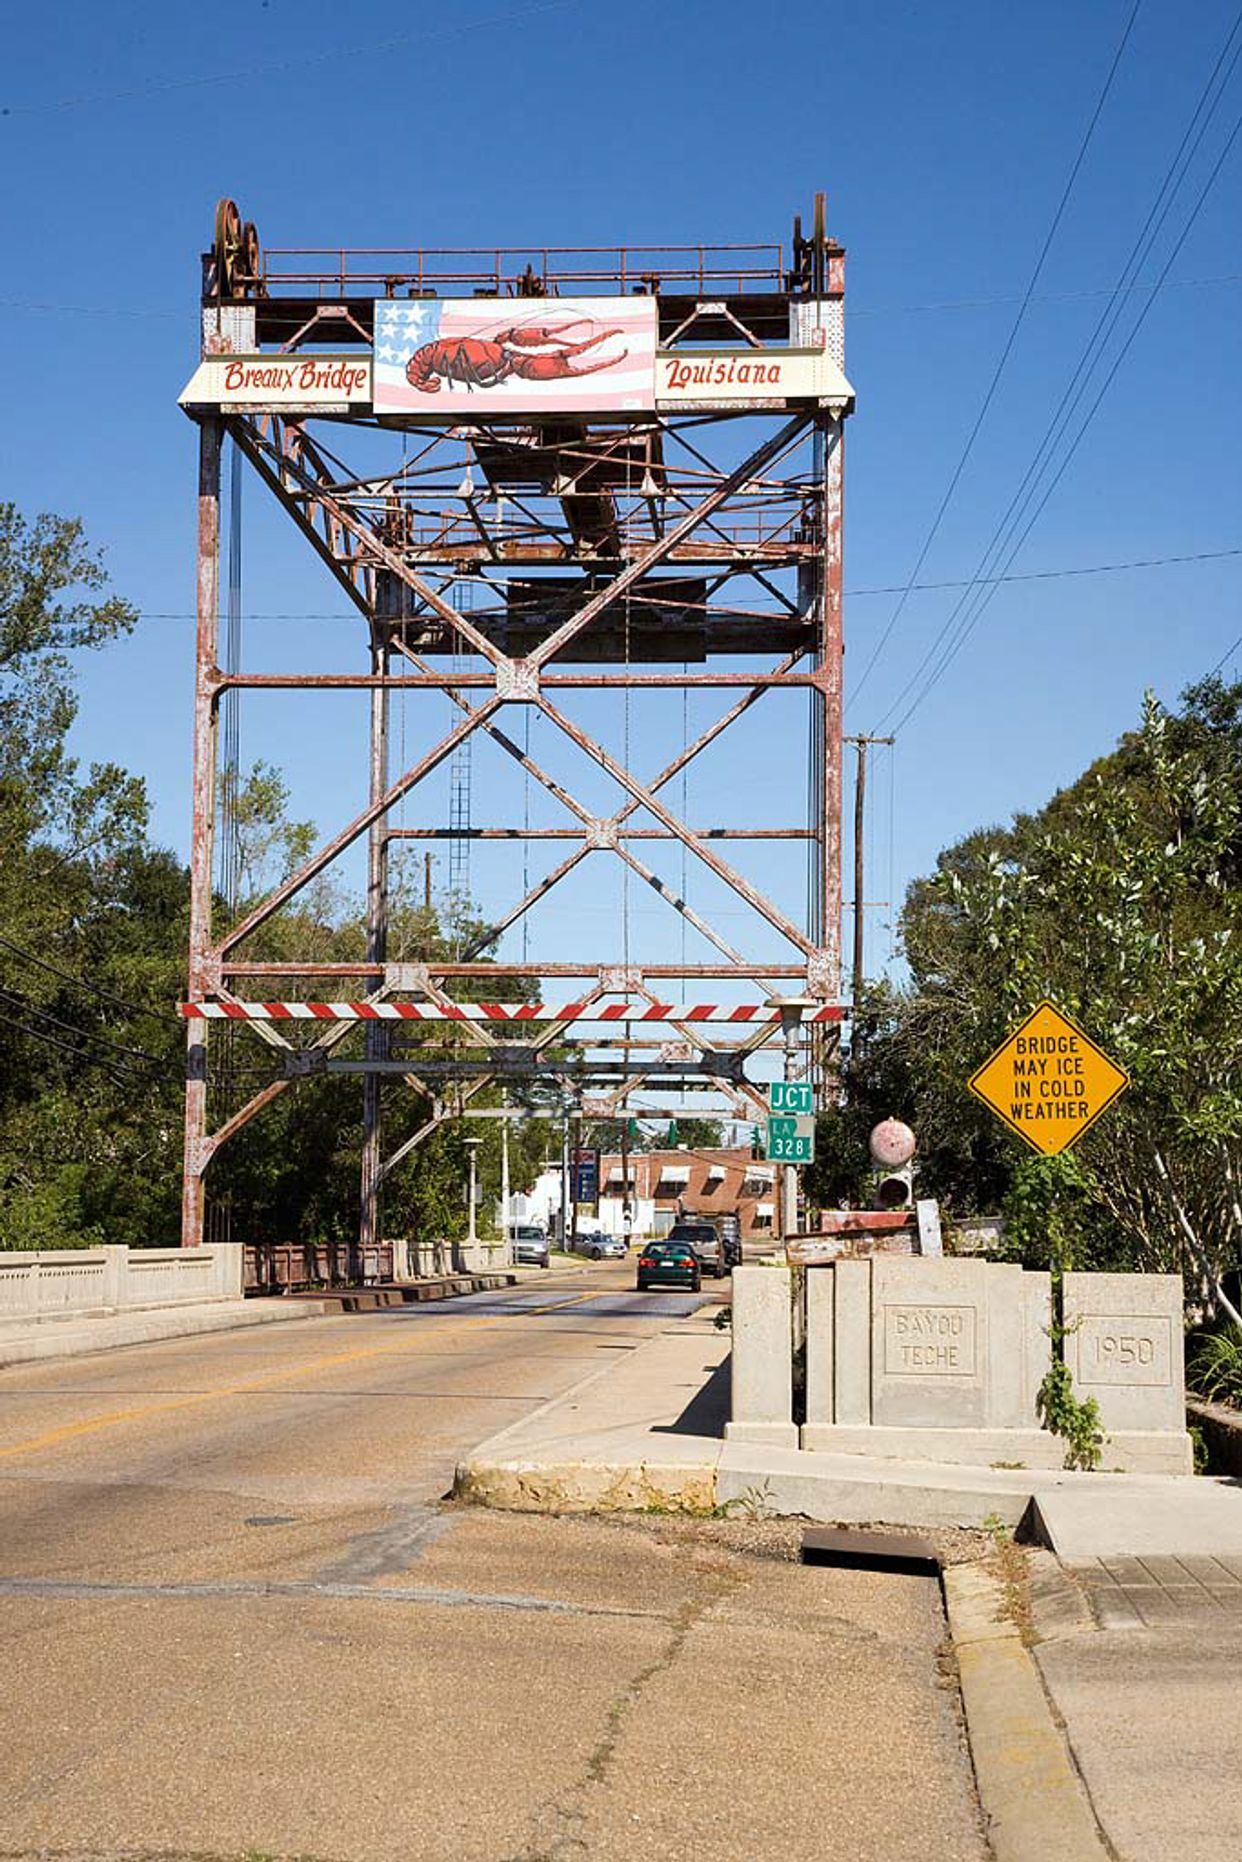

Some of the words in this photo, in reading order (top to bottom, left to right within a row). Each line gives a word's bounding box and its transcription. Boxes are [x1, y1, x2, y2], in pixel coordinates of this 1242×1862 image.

[225, 361, 299, 392] Breaux
[299, 360, 367, 396] Bridge
[666, 356, 782, 390] Louisiana
[1016, 1036, 1078, 1055] BRIDGE
[1013, 1059, 1047, 1076] MAY
[1057, 1058, 1084, 1075] ICE
[773, 1087, 809, 1107] JCT
[1014, 1081, 1031, 1098] IN
[1040, 1080, 1085, 1097] COLD
[1011, 1102, 1089, 1120] WEATHER
[772, 1121, 792, 1135] LA
[775, 1139, 804, 1155] 328
[896, 1311, 963, 1335] BAYOU
[901, 1345, 959, 1366] TECHE
[1095, 1336, 1154, 1365] 1950
